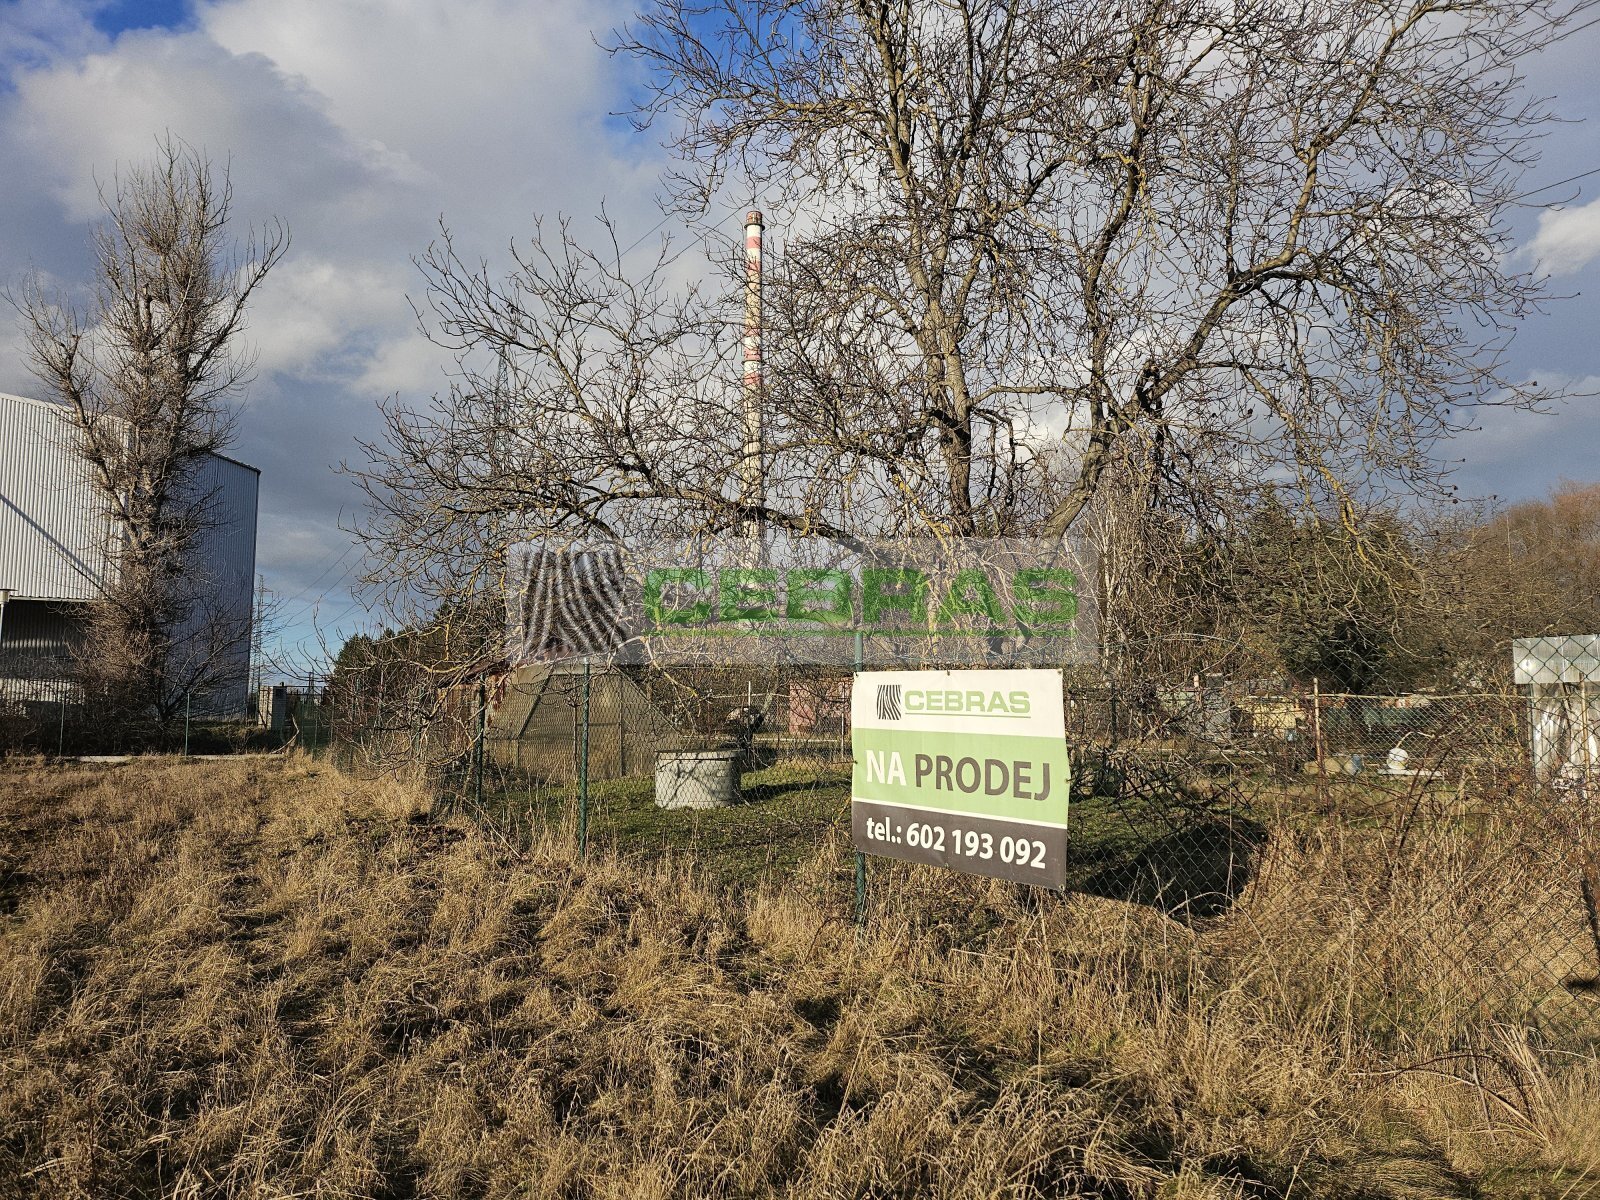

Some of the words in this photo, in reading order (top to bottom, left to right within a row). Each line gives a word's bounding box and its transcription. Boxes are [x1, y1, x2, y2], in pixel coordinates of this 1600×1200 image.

[904, 690, 1031, 714] CEBRAS
[865, 749, 907, 786] NA
[915, 753, 1051, 801] PRODEJ
[866, 816, 902, 844] tel.:
[906, 822, 946, 852] 602
[951, 829, 994, 860] 193
[999, 836, 1047, 869] 092
